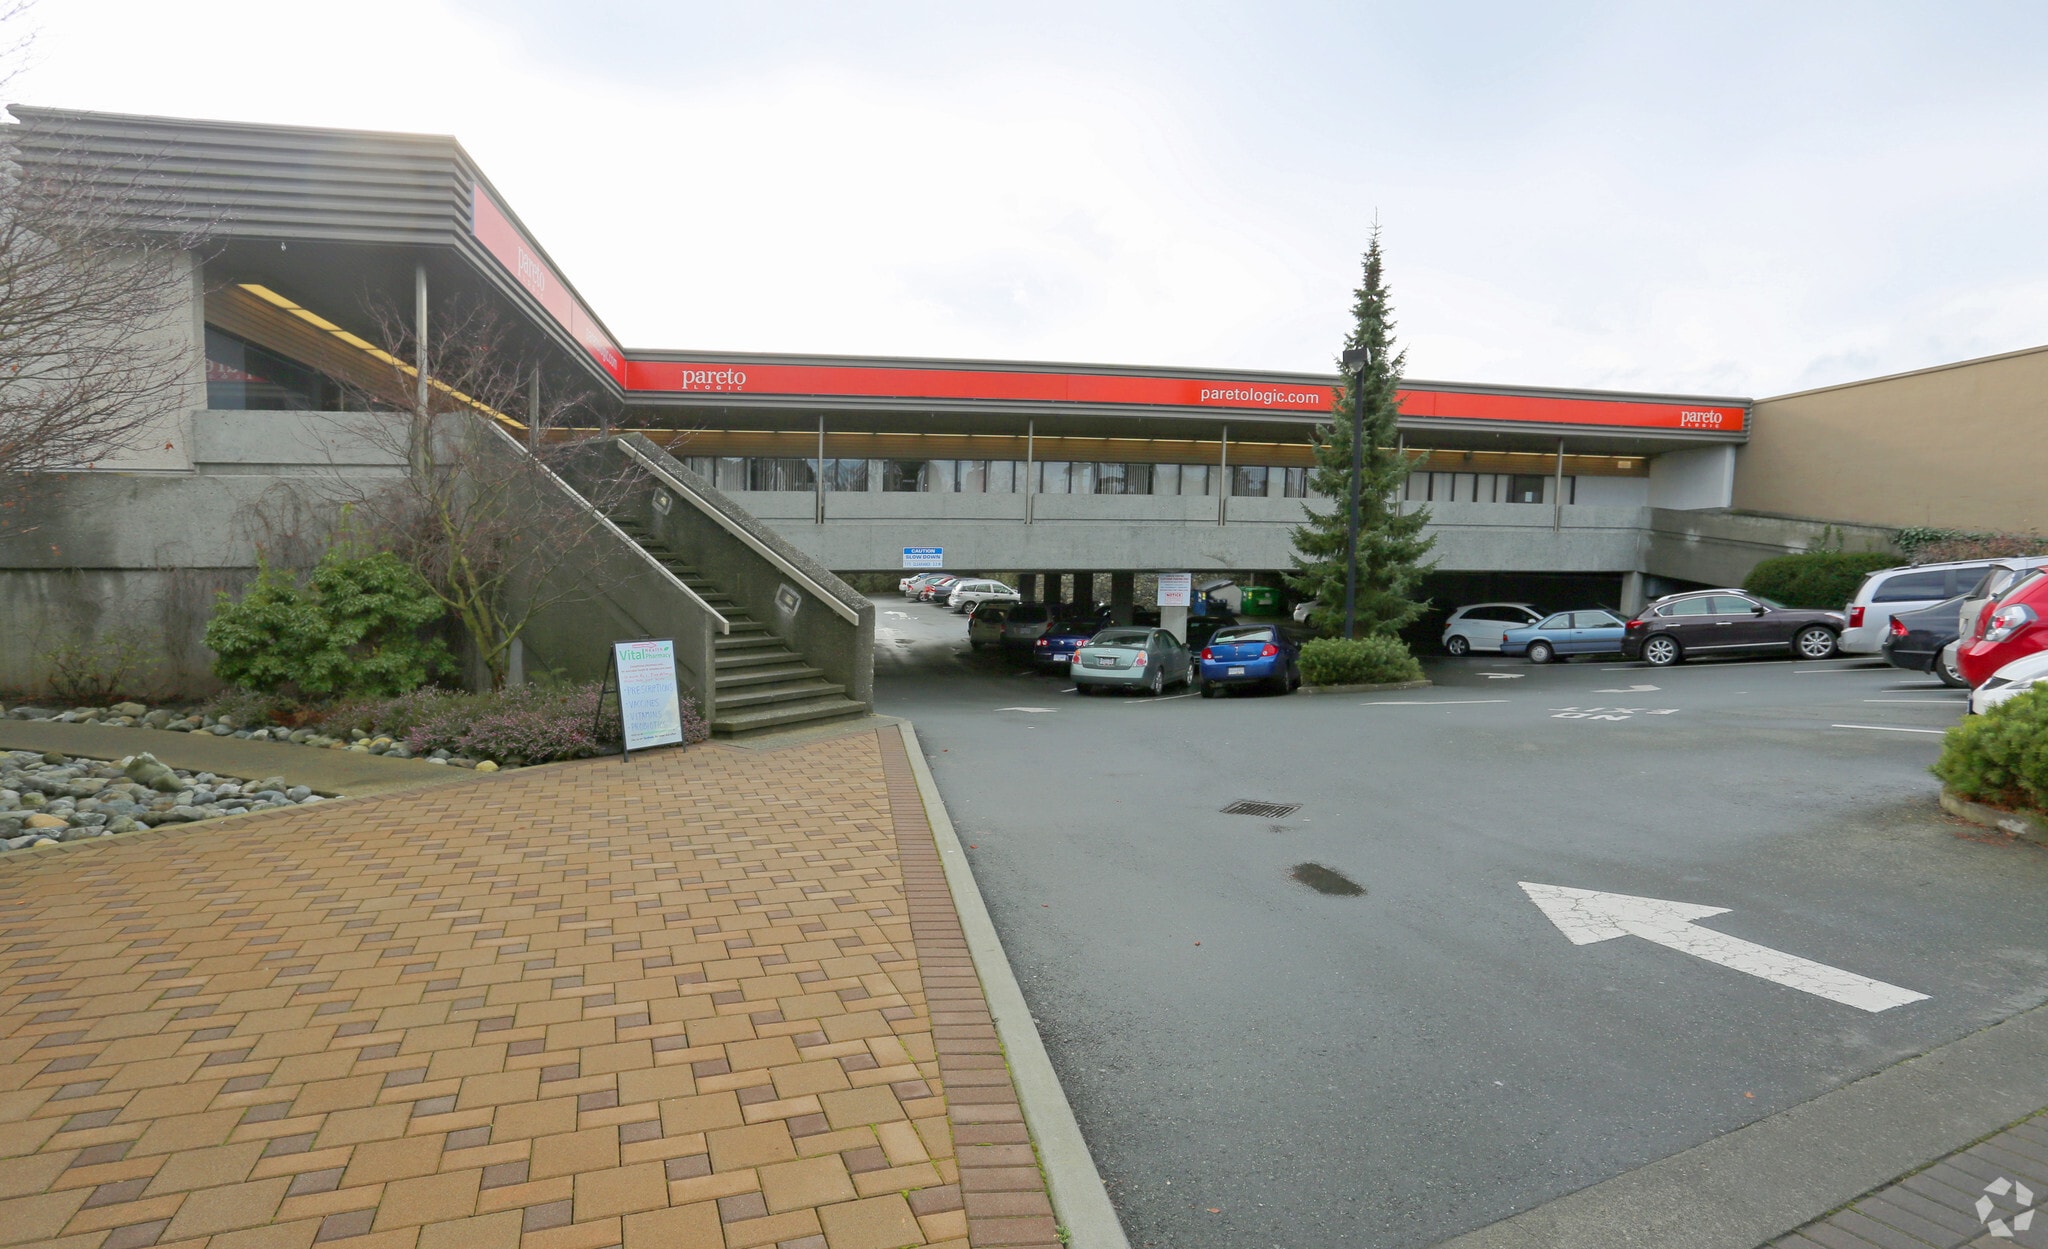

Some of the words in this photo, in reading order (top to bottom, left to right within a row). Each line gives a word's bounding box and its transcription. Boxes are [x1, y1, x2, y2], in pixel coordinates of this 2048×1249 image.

[682, 368, 747, 389] pareto
[1200, 388, 1319, 405] paretologic.com
[1680, 410, 1723, 427] pareto
[619, 649, 646, 661] Vital
